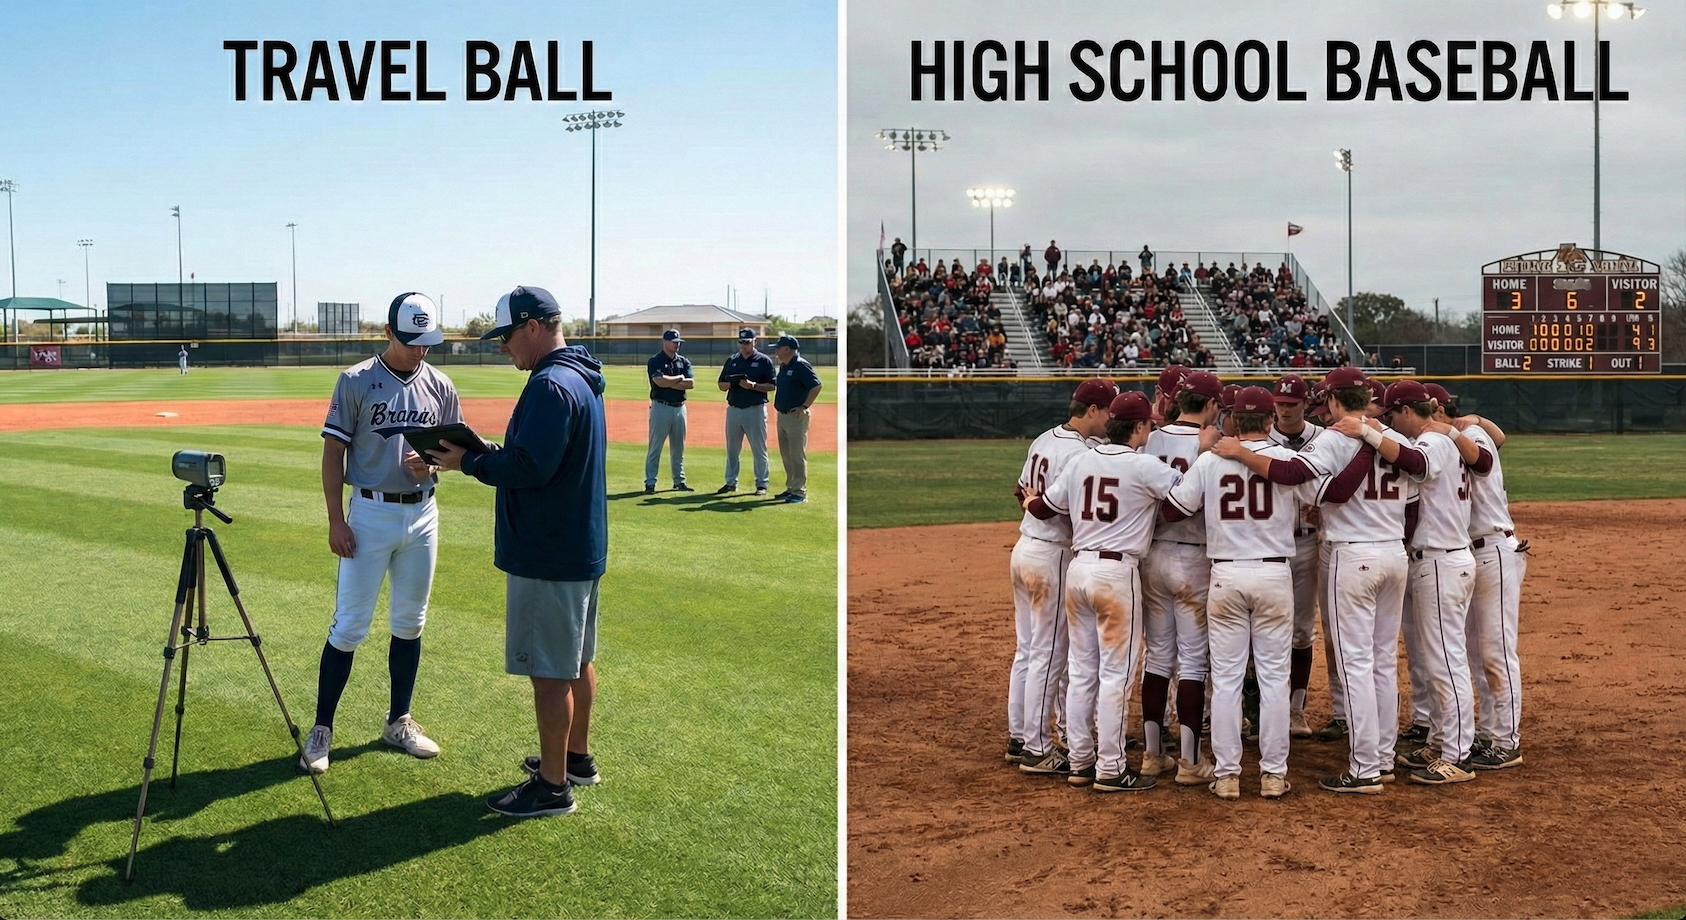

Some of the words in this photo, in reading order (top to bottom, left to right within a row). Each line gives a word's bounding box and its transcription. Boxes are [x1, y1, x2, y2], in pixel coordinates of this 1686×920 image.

[1492, 278, 1527, 290] HOME
[1611, 278, 1658, 290] VISITOR
[1511, 291, 1521, 309] 3
[1566, 291, 1577, 309] 6
[1635, 291, 1646, 309] 2
[1491, 325, 1521, 335] HOME
[1487, 340, 1524, 350] VISITOR
[1494, 358, 1521, 368] BALL
[1522, 356, 1531, 370] 2
[1546, 358, 1582, 369] STRIKE
[1611, 358, 1632, 369] OUT
[1030, 452, 1049, 495] 16
[1080, 474, 1120, 524] 15
[1219, 473, 1274, 521] 20
